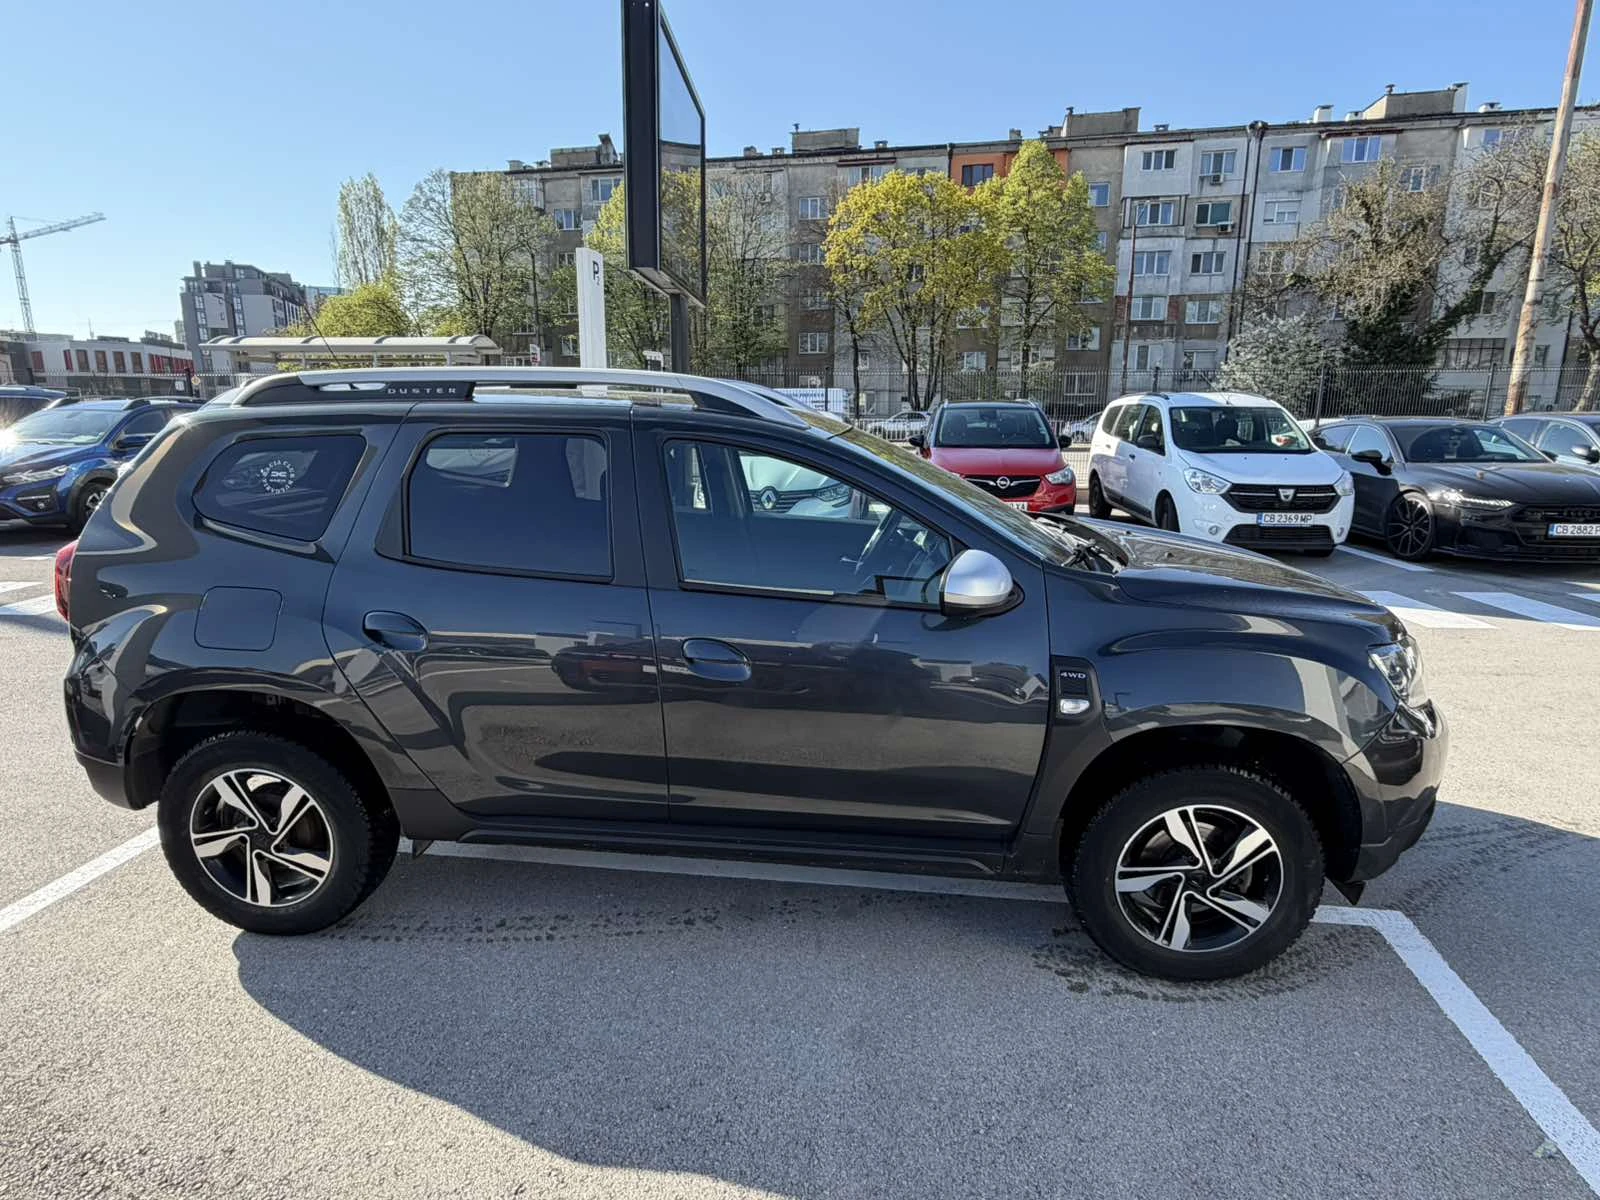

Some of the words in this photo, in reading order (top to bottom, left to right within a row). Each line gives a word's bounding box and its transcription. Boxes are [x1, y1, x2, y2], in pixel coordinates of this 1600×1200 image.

[387, 387, 457, 395] DUSTER
[1277, 514, 1300, 523] 2369
[1060, 671, 1086, 679] 4WD
